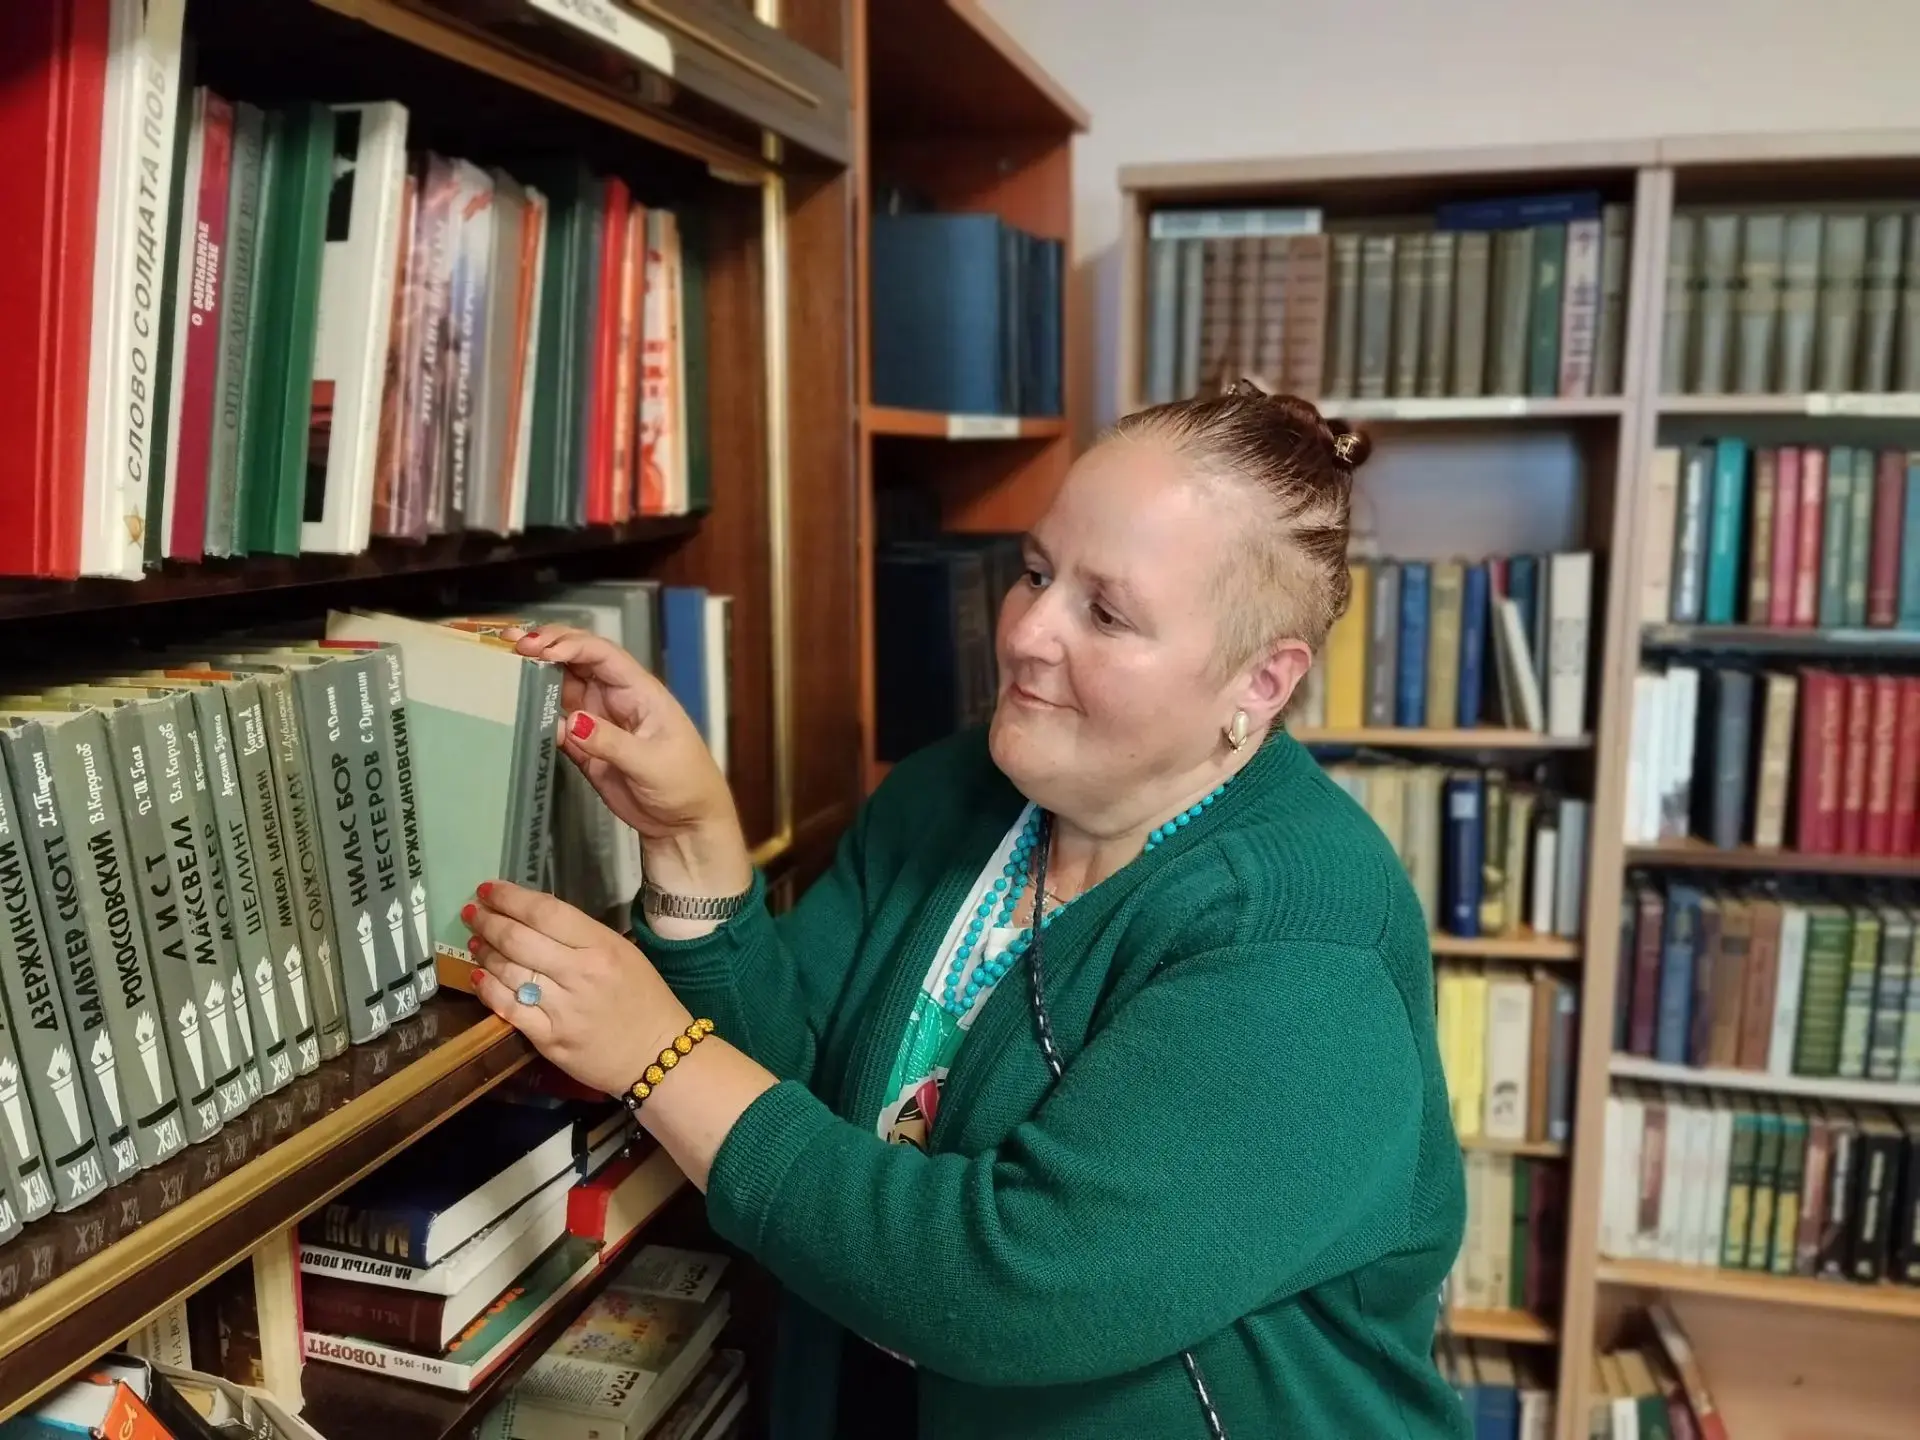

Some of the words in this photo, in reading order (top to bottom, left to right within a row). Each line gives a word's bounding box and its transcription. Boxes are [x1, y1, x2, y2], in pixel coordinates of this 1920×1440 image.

[134, 155, 160, 339] СОЛДАТА
[194, 220, 209, 309] МИХАИЛЕ
[204, 242, 219, 311] ФРУНЗЕ
[192, 314, 202, 326] О
[128, 347, 147, 482] СЛОВО
[256, 769, 280, 863] НАЛБАНДЯН
[332, 752, 354, 812] БОР
[390, 707, 422, 879] КРЖИЖАНОВСКИЙ
[364, 750, 396, 892] НЕСТЕРОВ
[526, 815, 543, 885] ДАРВИН
[44, 836, 79, 921] СКОТТ
[170, 815, 217, 965] МАКСВЕЛЛ
[204, 823, 234, 941] МОЛЬЕР
[229, 819, 261, 936] ШЕЛЛИНГ
[339, 813, 368, 907] НИЛЬС
[87, 829, 146, 1010] РОКОССОВСКИЙ
[145, 853, 188, 961] ЛИСТ
[272, 866, 292, 927] МИКАЭЛ
[64, 928, 104, 1032] ВАЛЬТЕР
[394, 984, 418, 1015] ЖЗЛ
[270, 1051, 293, 1087] ЖЗЛ
[299, 1035, 320, 1070] ЖЗЛ
[198, 1099, 220, 1131] ЖЗЛ
[219, 1079, 247, 1114] ЖЗЛ
[112, 1136, 139, 1173] ЖЗЛ
[154, 1117, 181, 1155] ЖЗЛ
[20, 1171, 50, 1214] ЖЗЛ
[67, 1155, 102, 1199] ЖЗЛ
[342, 1257, 393, 1277] КРУТЫХ
[396, 1267, 412, 1280] НА
[307, 1338, 387, 1369] ГОВОРЯТ
